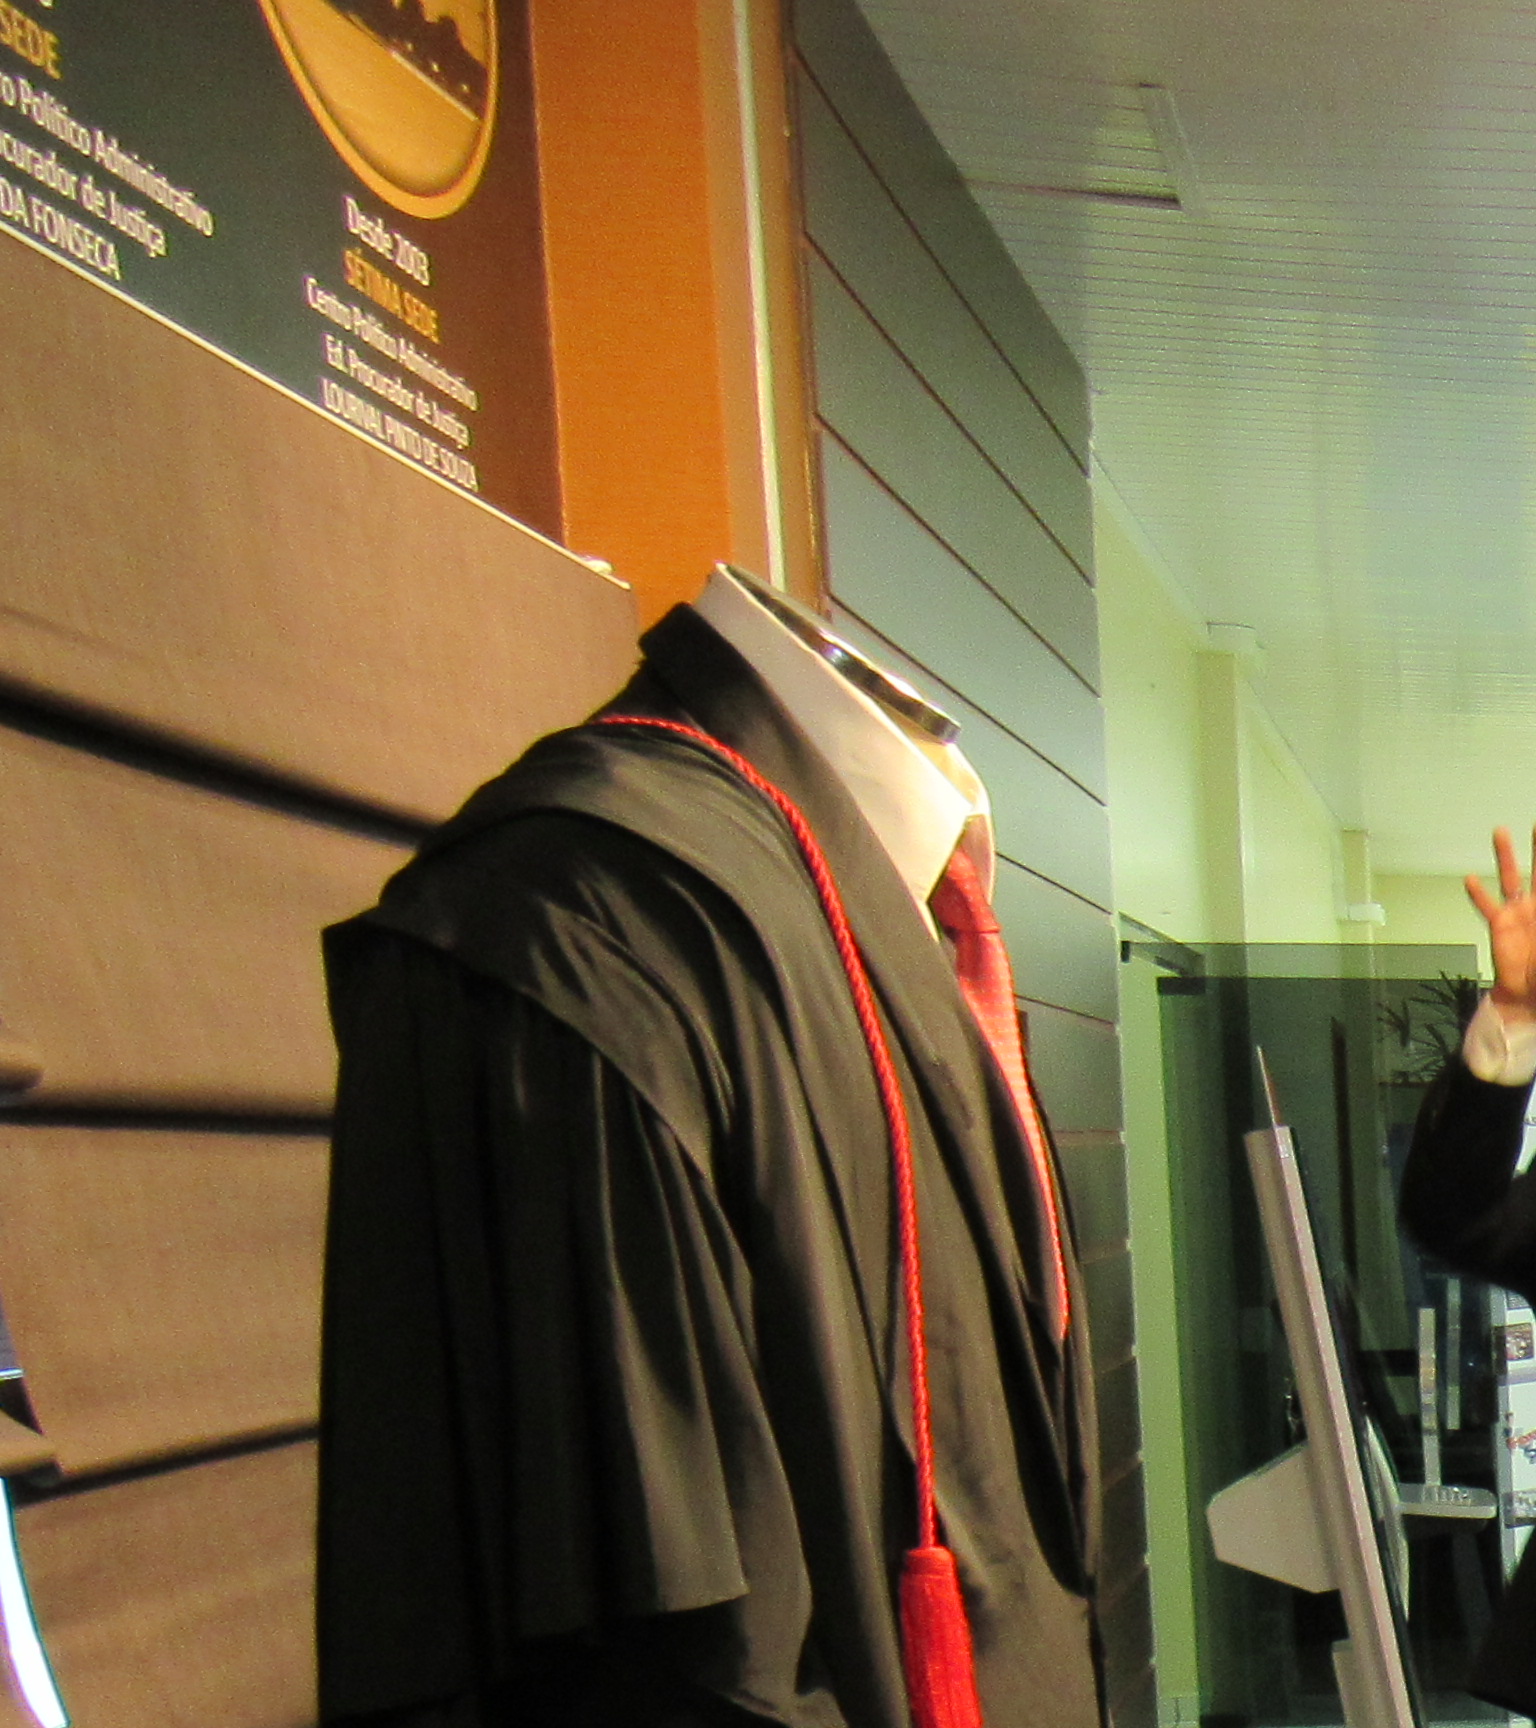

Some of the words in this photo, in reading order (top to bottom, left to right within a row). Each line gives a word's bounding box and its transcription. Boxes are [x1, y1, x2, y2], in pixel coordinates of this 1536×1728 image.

[80, 174, 106, 220] de
[29, 195, 123, 281] FONSECA
[344, 195, 393, 260] Desde
[402, 290, 440, 344] SEDE
[415, 390, 433, 426] de
